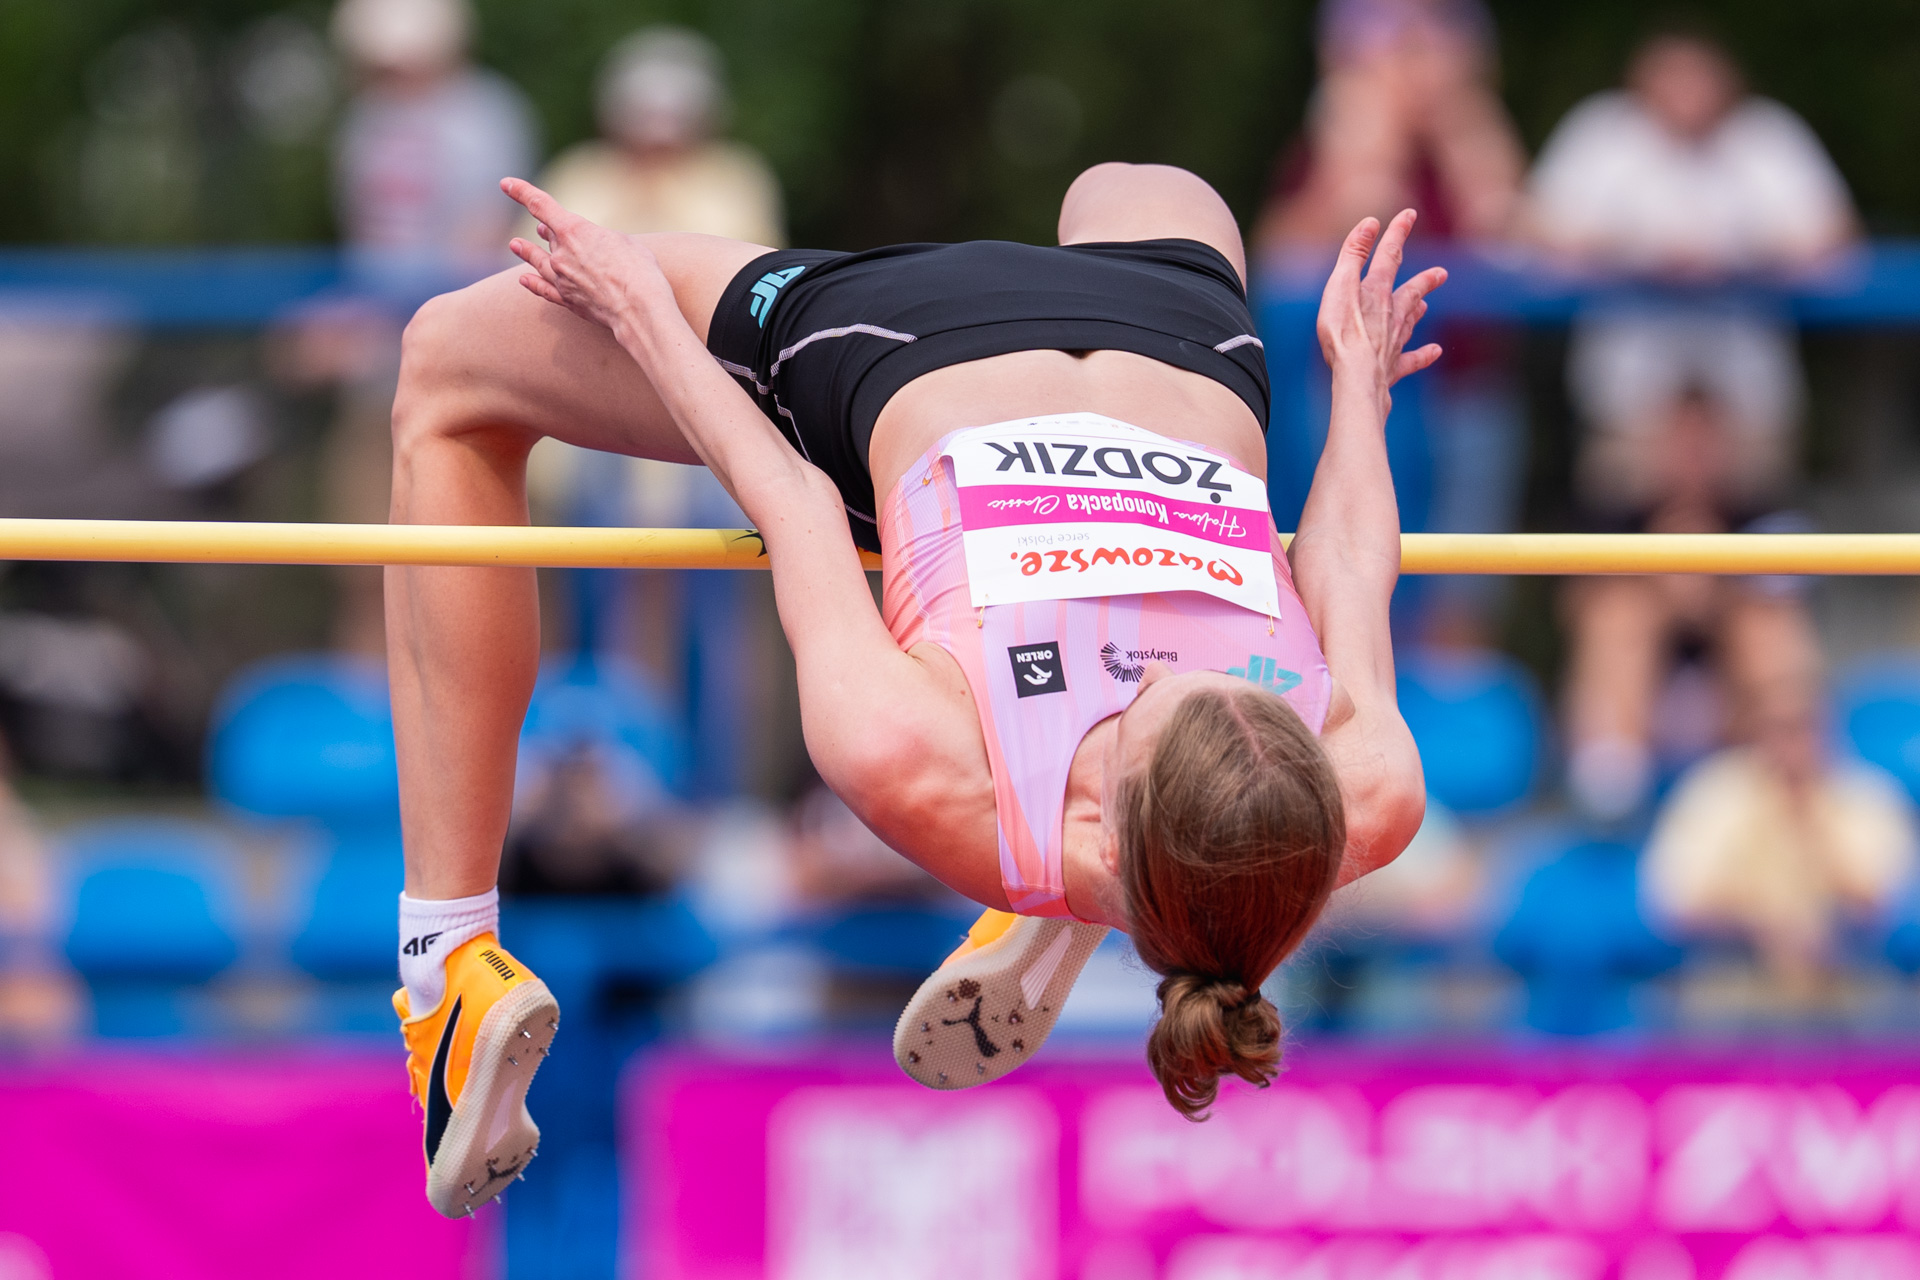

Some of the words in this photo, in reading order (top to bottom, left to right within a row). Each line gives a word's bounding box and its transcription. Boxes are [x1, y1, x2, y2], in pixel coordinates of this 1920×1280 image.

[751, 266, 805, 328] 4F
[984, 442, 1232, 503] ŻODZIK
[988, 495, 1060, 515] Classic
[1067, 493, 1169, 524] Konopacka
[1173, 510, 1247, 538] Halina
[1017, 533, 1054, 546] Polski
[1058, 532, 1090, 542] serce
[1016, 650, 1053, 663] ORLEN
[1126, 648, 1178, 662] Białystok
[403, 932, 443, 956] 4F
[480, 950, 515, 981] PUMA
